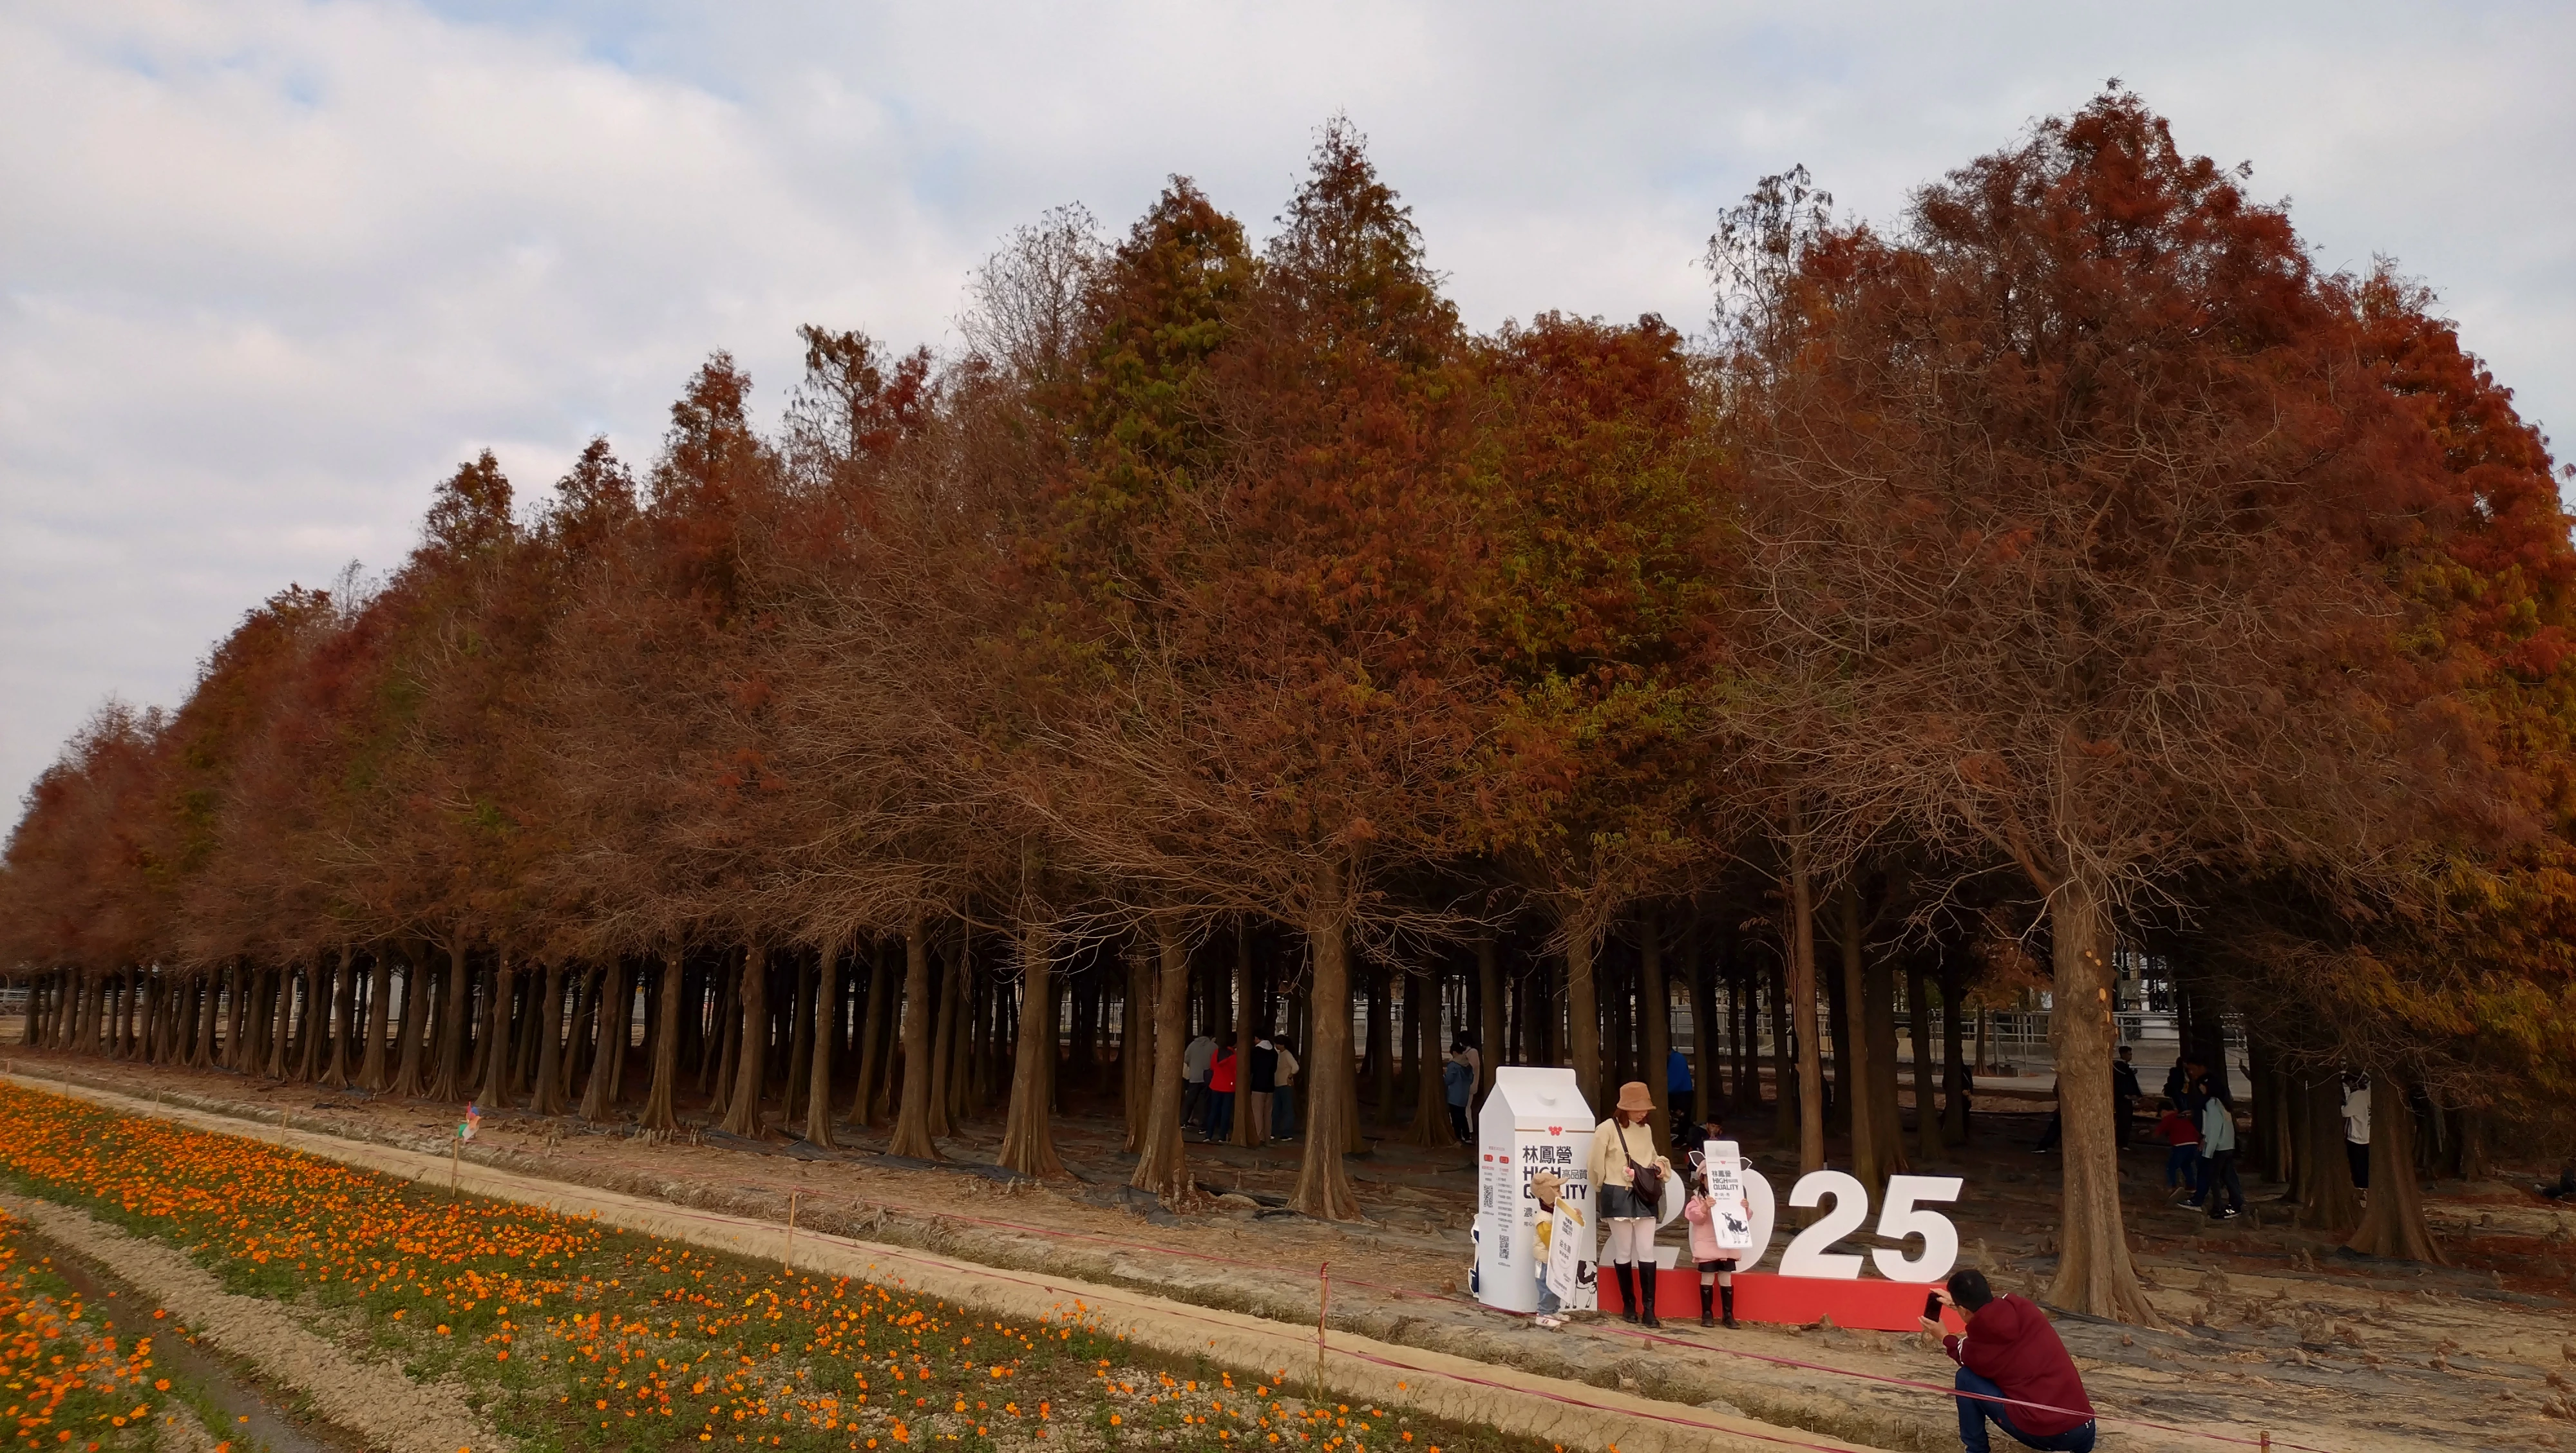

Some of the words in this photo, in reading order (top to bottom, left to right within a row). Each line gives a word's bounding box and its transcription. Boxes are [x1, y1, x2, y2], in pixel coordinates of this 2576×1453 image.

[1522, 1145, 1572, 1164] 林鳳營
[1562, 1169, 1588, 1180] 高品質
[1523, 1183, 1588, 1199] QITY
